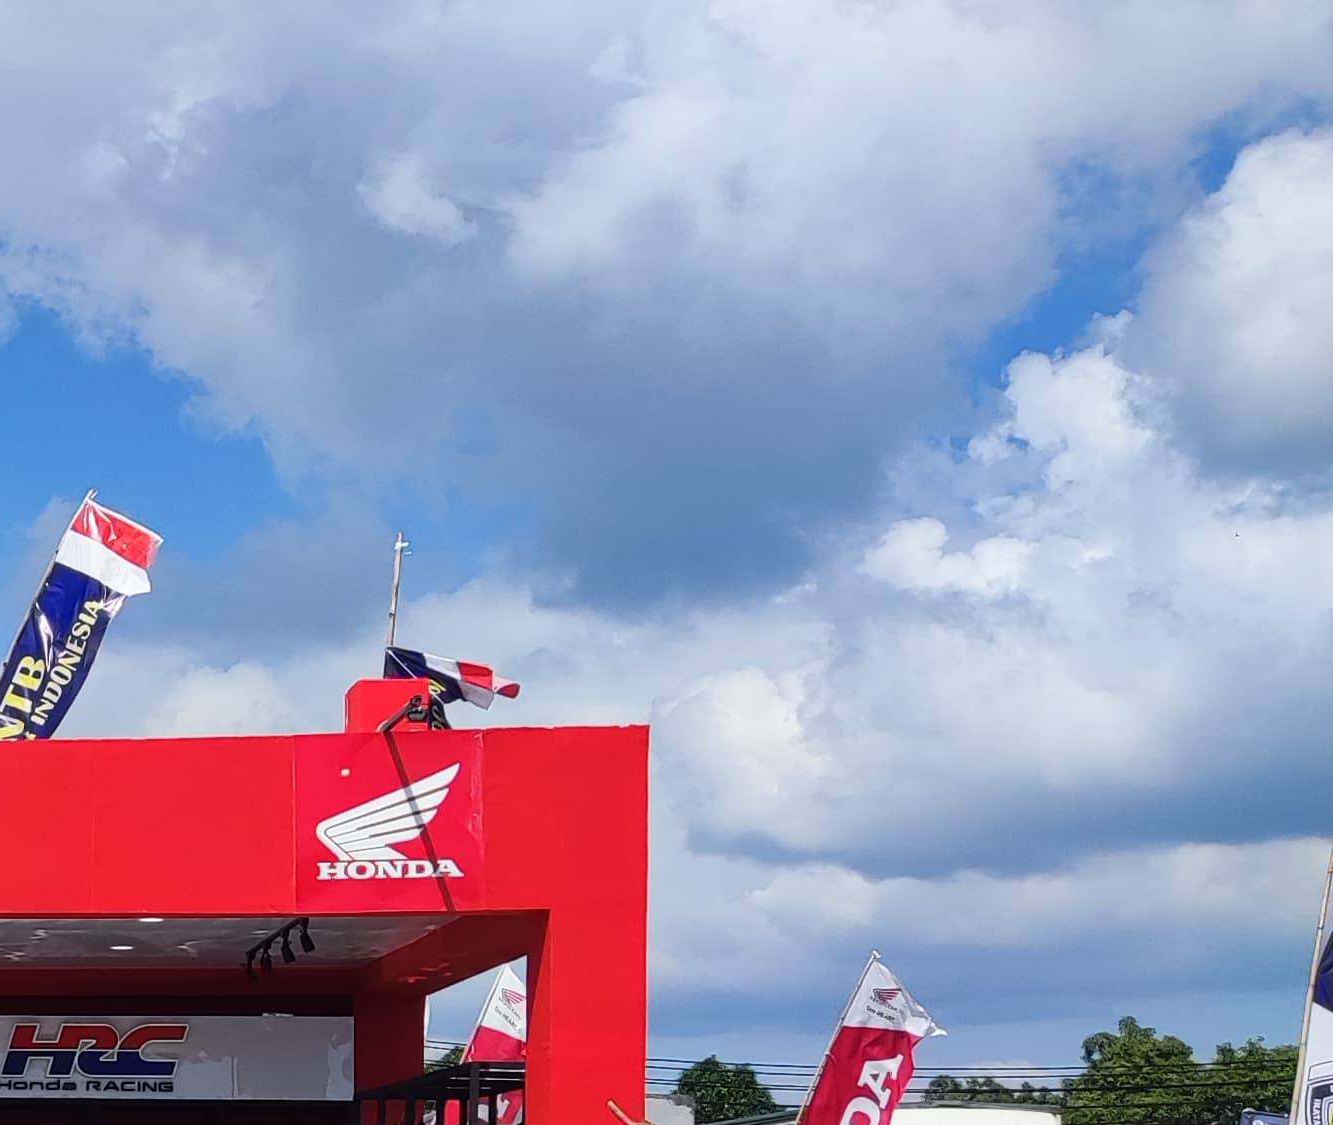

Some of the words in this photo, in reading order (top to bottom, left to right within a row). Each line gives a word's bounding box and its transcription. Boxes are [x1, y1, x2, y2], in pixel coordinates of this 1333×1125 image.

[31, 599, 103, 726] INDONESIA
[316, 859, 464, 881] HONDA
[0, 1023, 190, 1078] HRC
[85, 1080, 174, 1093] RACING
